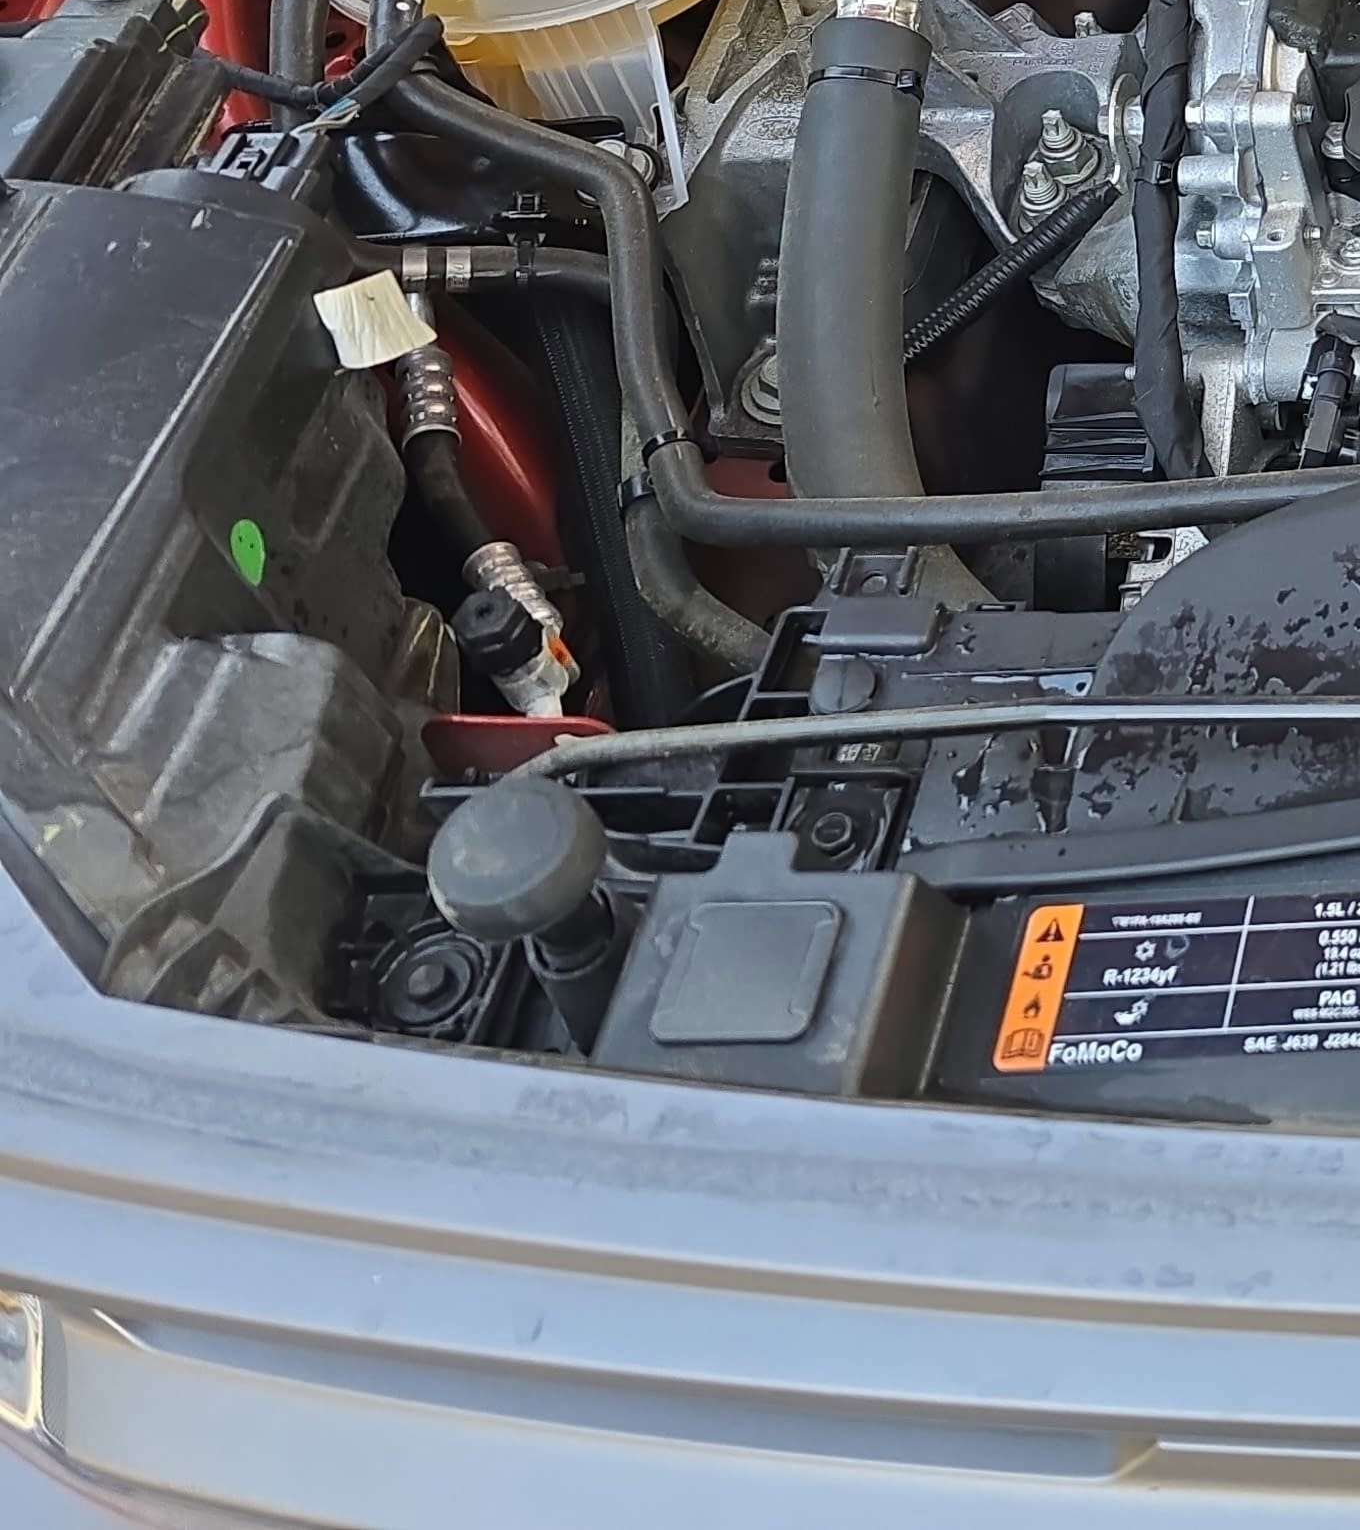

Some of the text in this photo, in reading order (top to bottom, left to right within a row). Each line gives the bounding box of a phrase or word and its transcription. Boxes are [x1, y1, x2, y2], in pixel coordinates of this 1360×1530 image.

[1314, 902, 1346, 919] 1.5L
[1318, 929, 1358, 946] 0.550
[1102, 965, 1179, 986] R-1234yf
[1318, 989, 1357, 1007] PAG
[1047, 1039, 1143, 1065] FoMoCo
[1243, 1035, 1278, 1053] SAE
[1281, 1033, 1320, 1052] J639
